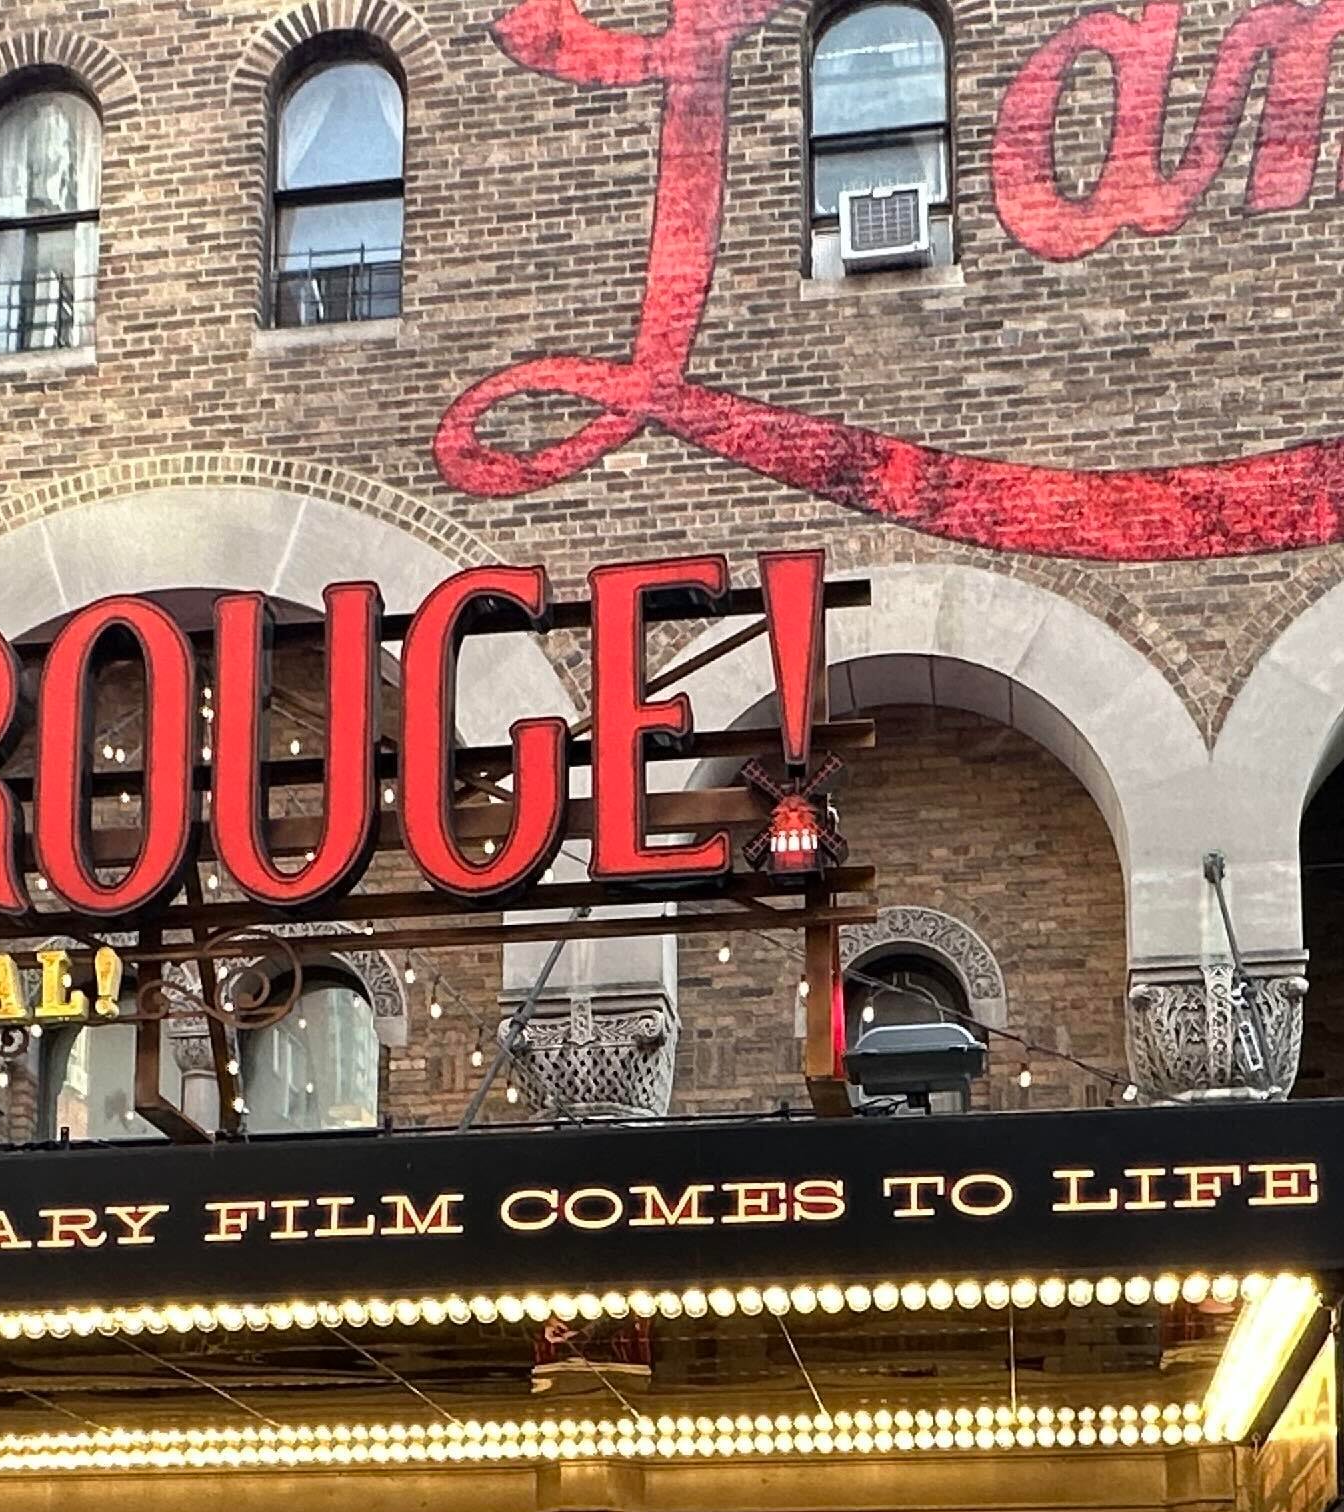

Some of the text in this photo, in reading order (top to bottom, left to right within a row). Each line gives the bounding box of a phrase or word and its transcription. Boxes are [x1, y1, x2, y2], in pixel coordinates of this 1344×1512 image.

[204, 1194, 464, 1242] FILM
[500, 1180, 846, 1231] COMES
[883, 1174, 1013, 1217] TO
[1052, 1162, 1320, 1212] LIFE
